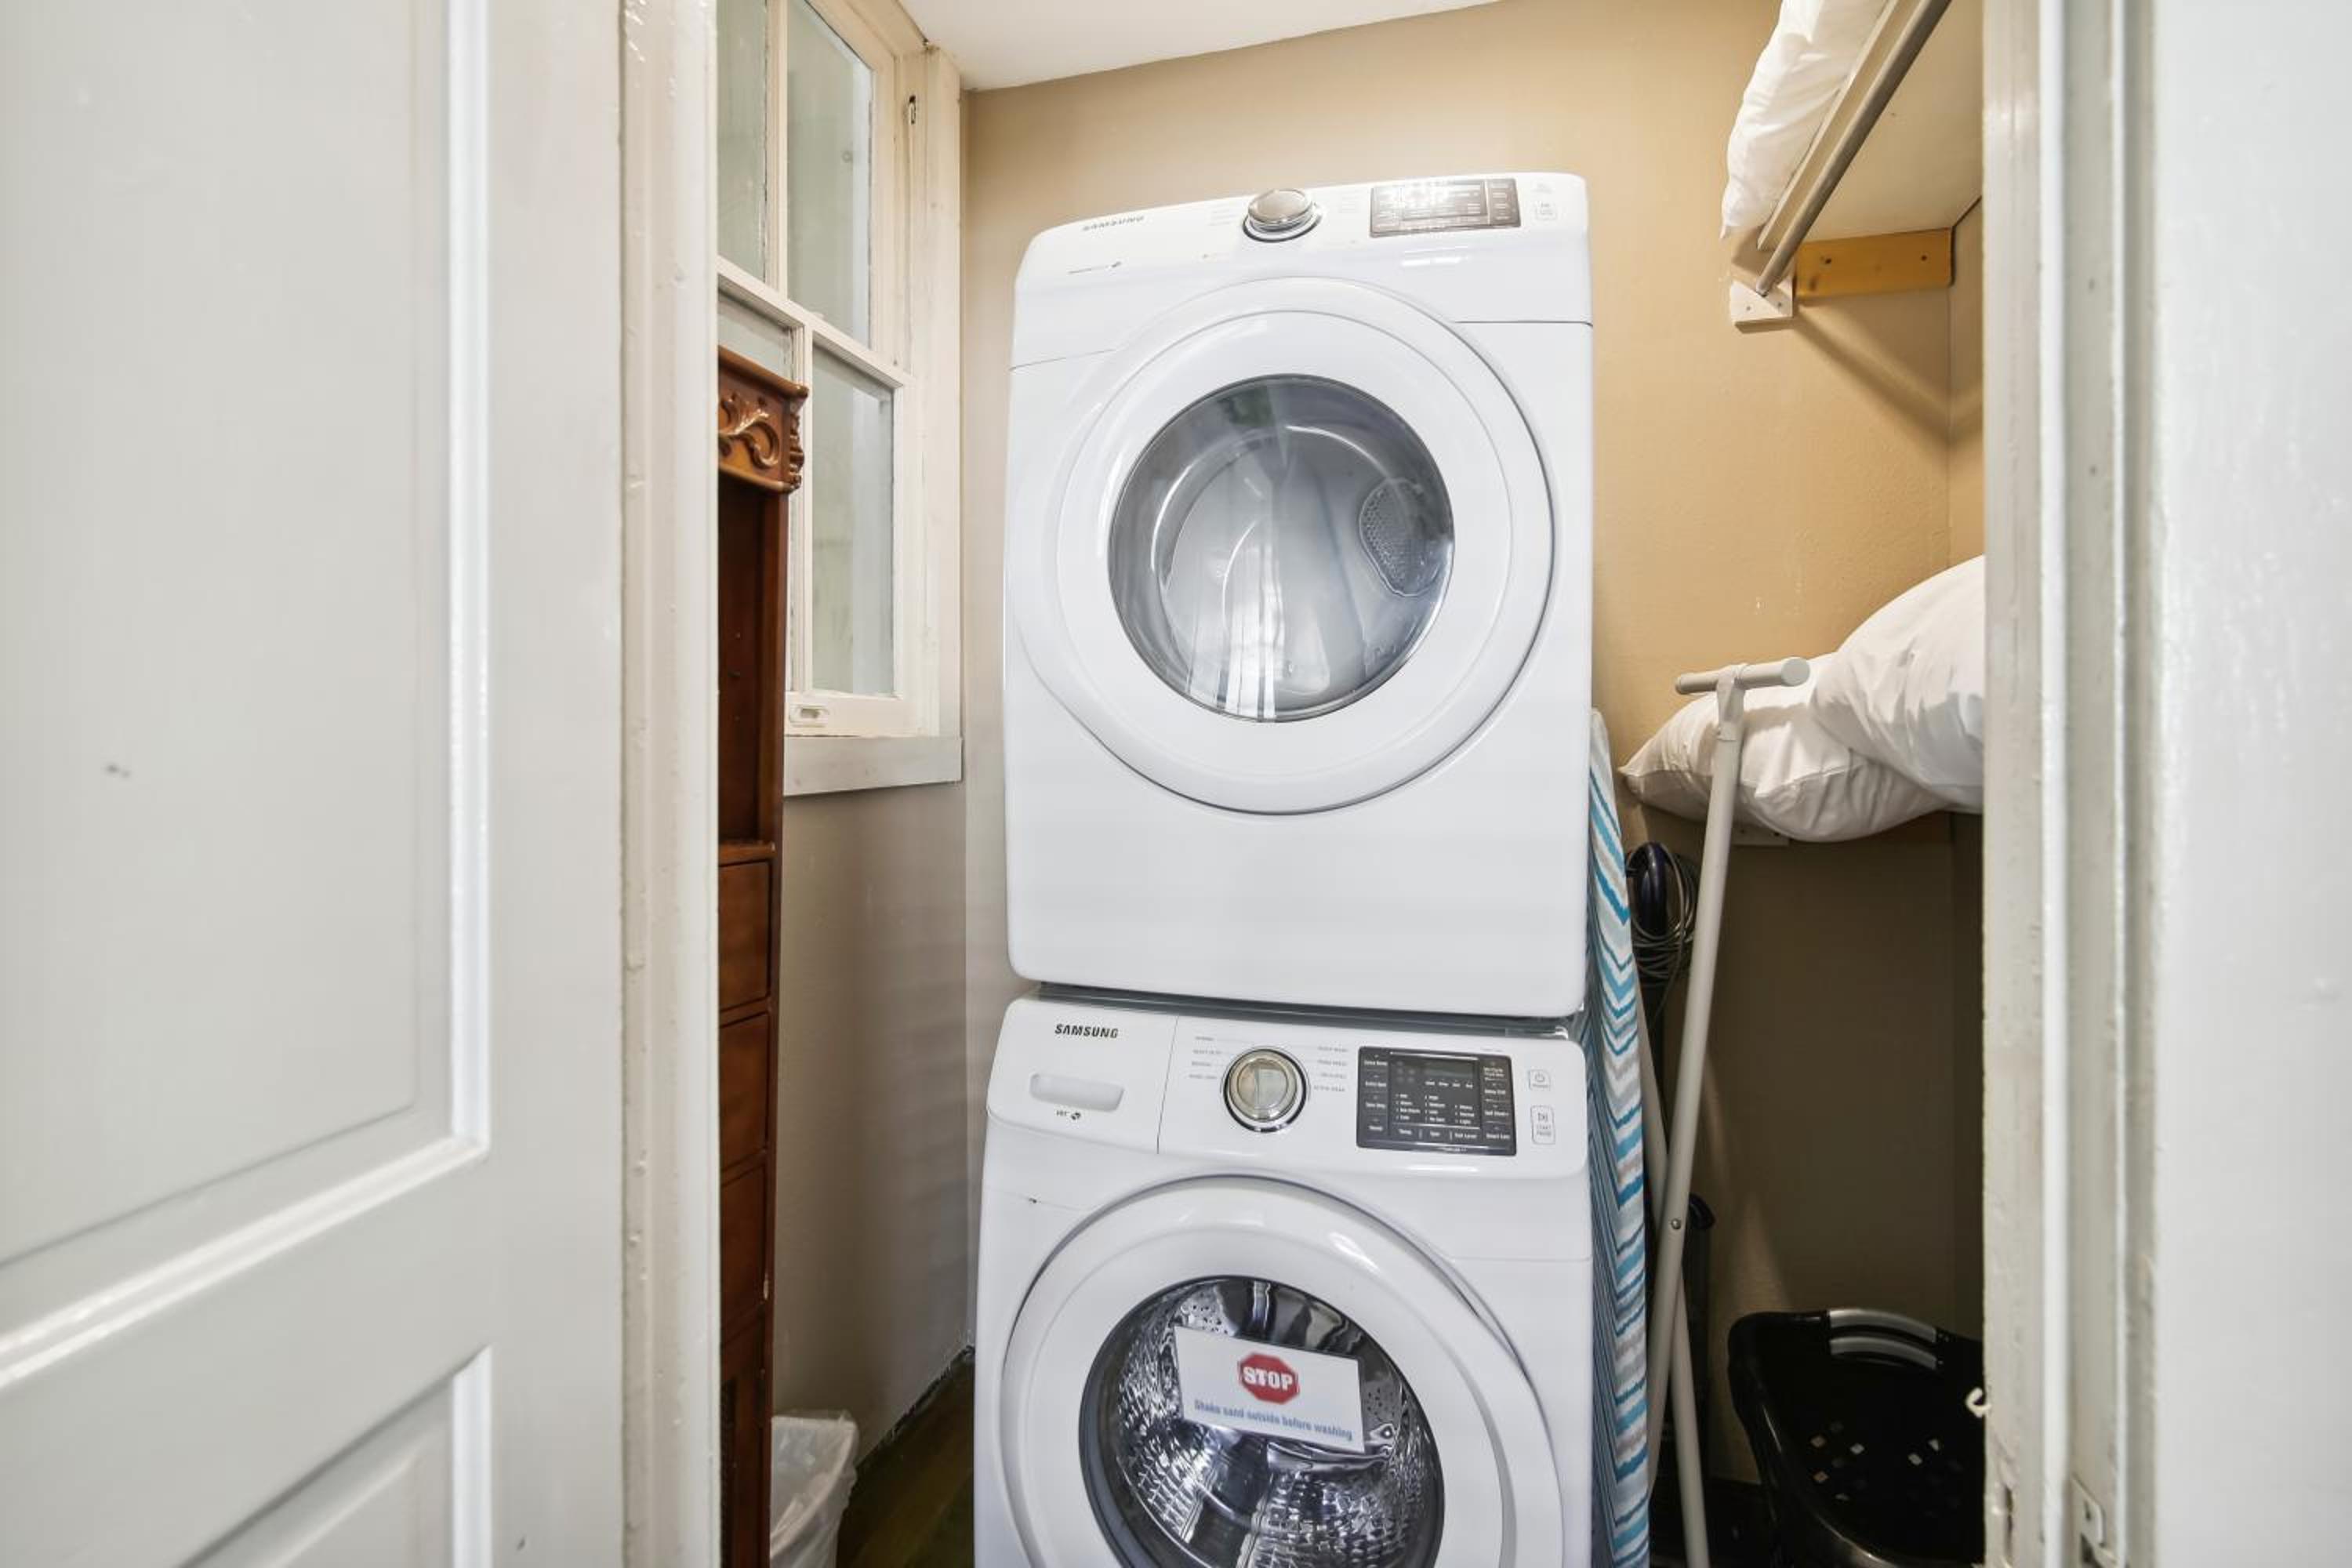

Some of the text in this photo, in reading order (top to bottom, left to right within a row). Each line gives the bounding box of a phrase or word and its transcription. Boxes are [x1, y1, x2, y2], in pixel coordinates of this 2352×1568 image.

[1054, 1023, 1119, 1039] SAMSUNG
[1243, 1366, 1294, 1391] STOP
[1194, 1399, 1353, 1442] Shake sand outside before washing
